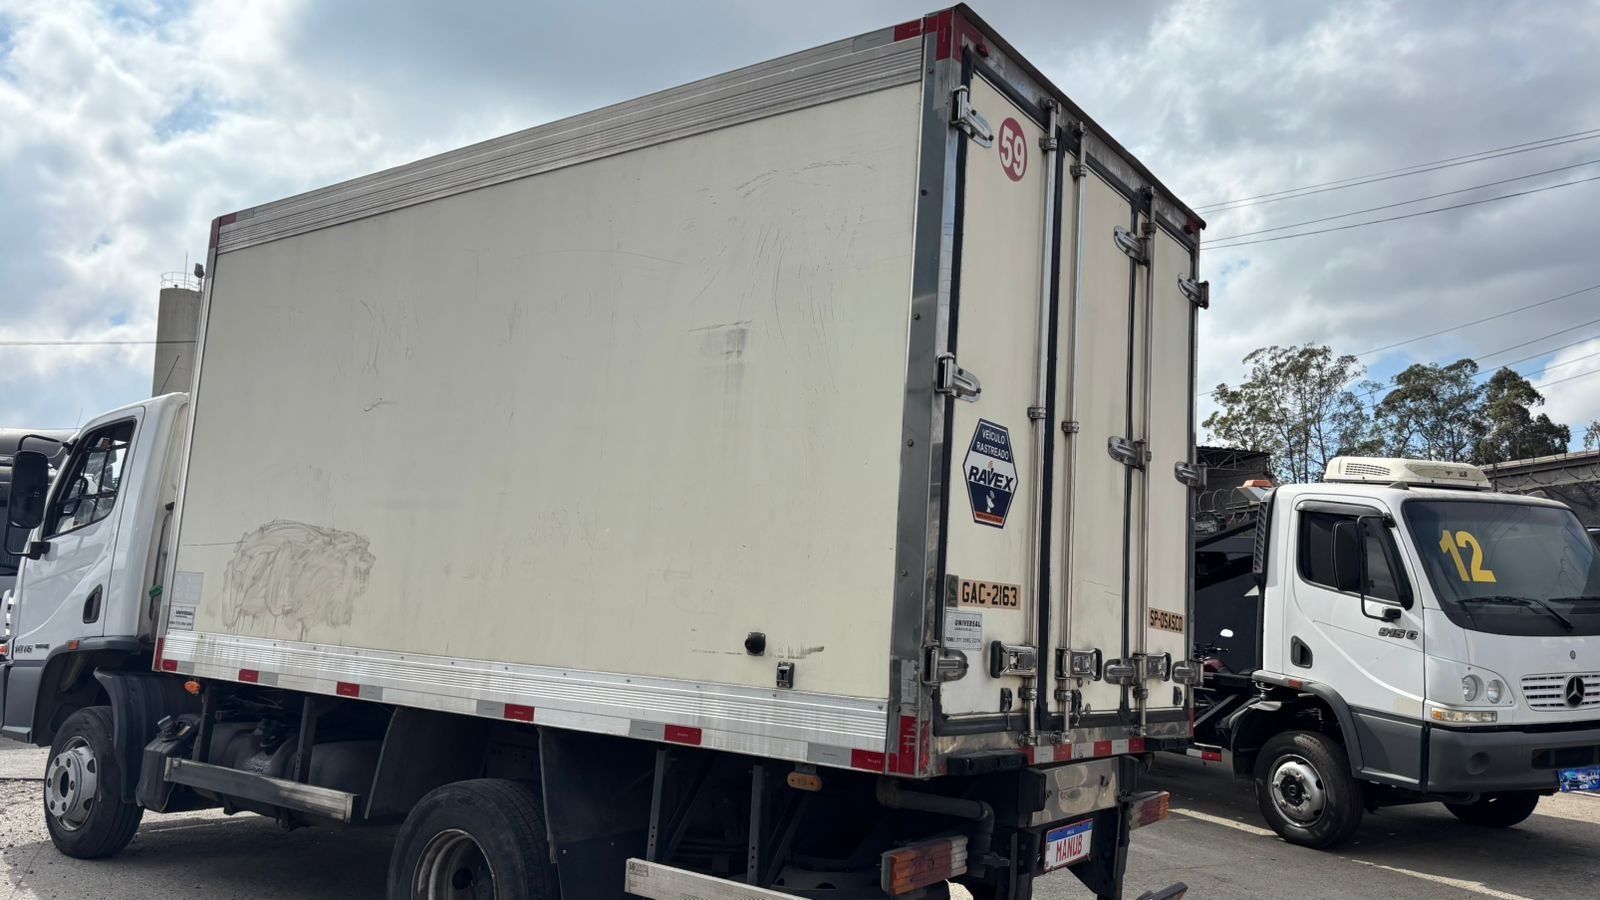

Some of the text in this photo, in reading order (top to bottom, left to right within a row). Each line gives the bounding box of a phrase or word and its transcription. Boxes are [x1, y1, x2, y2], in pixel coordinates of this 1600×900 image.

[1001, 126, 1025, 176] 59
[982, 428, 1006, 445] VEÍCULO
[976, 441, 1009, 460] RASTREADO
[968, 465, 1014, 491] RAVEX
[1439, 530, 1496, 582] 12
[962, 581, 1017, 607] GAC-2163
[1378, 627, 1418, 640] 915 C
